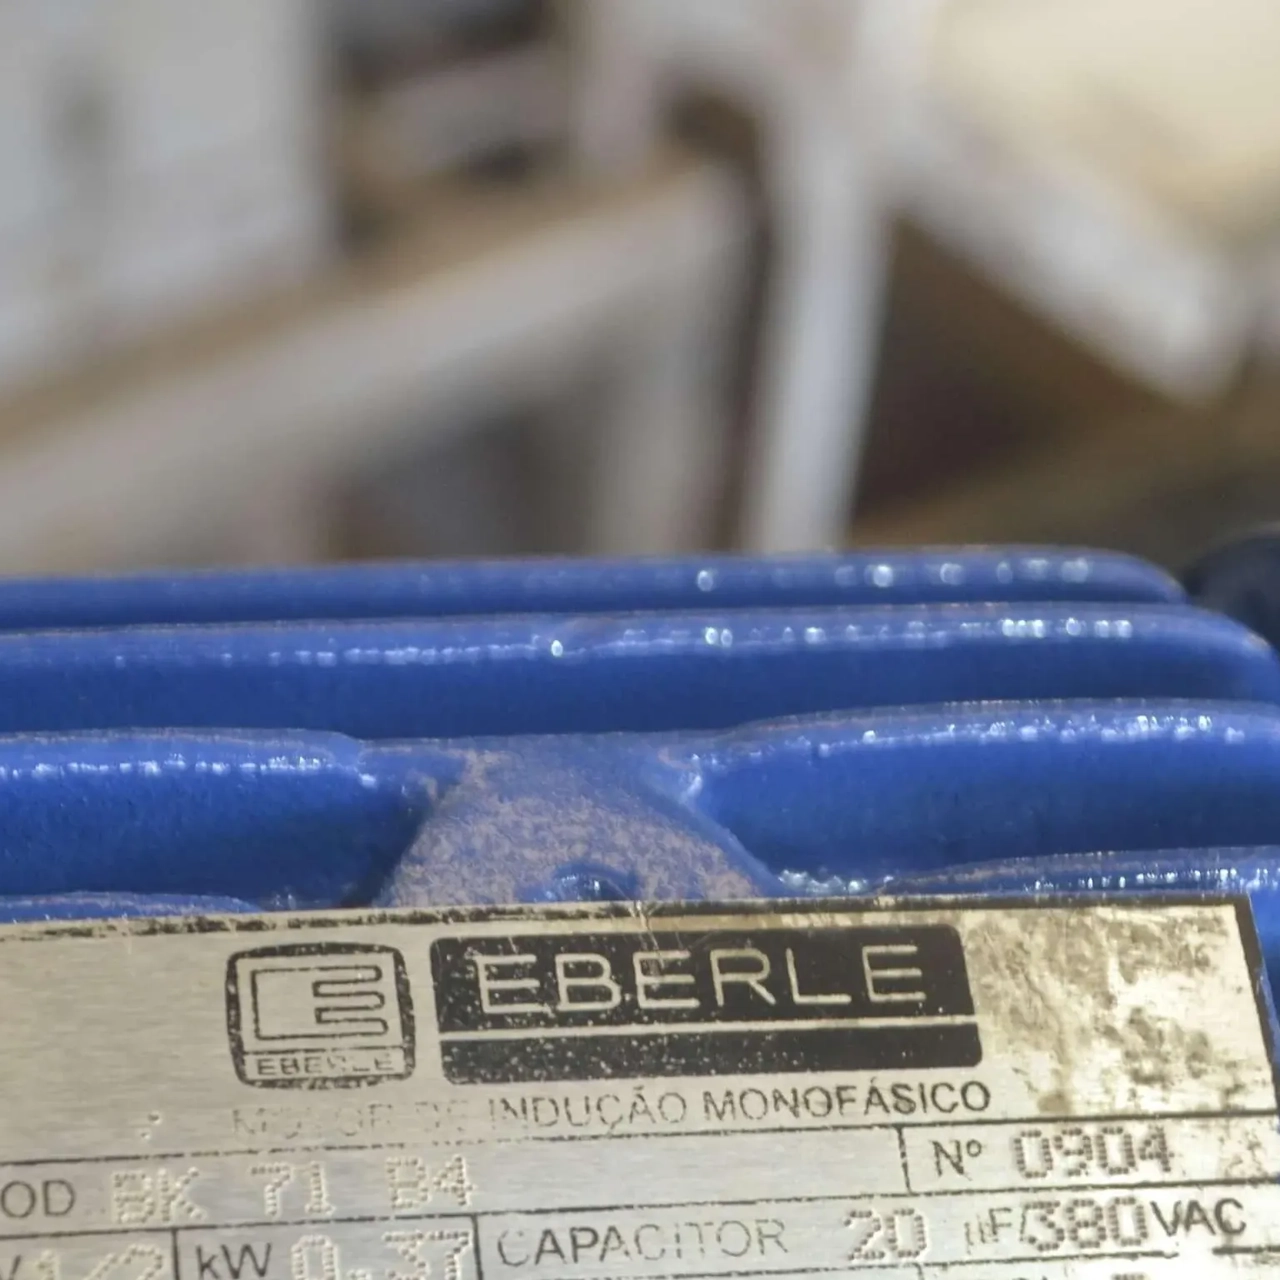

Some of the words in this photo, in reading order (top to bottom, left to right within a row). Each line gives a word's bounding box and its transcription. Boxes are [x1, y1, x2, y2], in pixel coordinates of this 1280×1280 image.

[475, 945, 926, 1014] EBERLE
[488, 1086, 687, 1131] INDUÇÃO
[704, 1077, 991, 1122] MONOFÁSICO
[1013, 1125, 1175, 1179] 0904
[112, 1166, 207, 1224] BK
[250, 1160, 336, 1219] 71
[497, 1219, 788, 1267] CAPACITOR
[843, 1207, 929, 1262] 20
